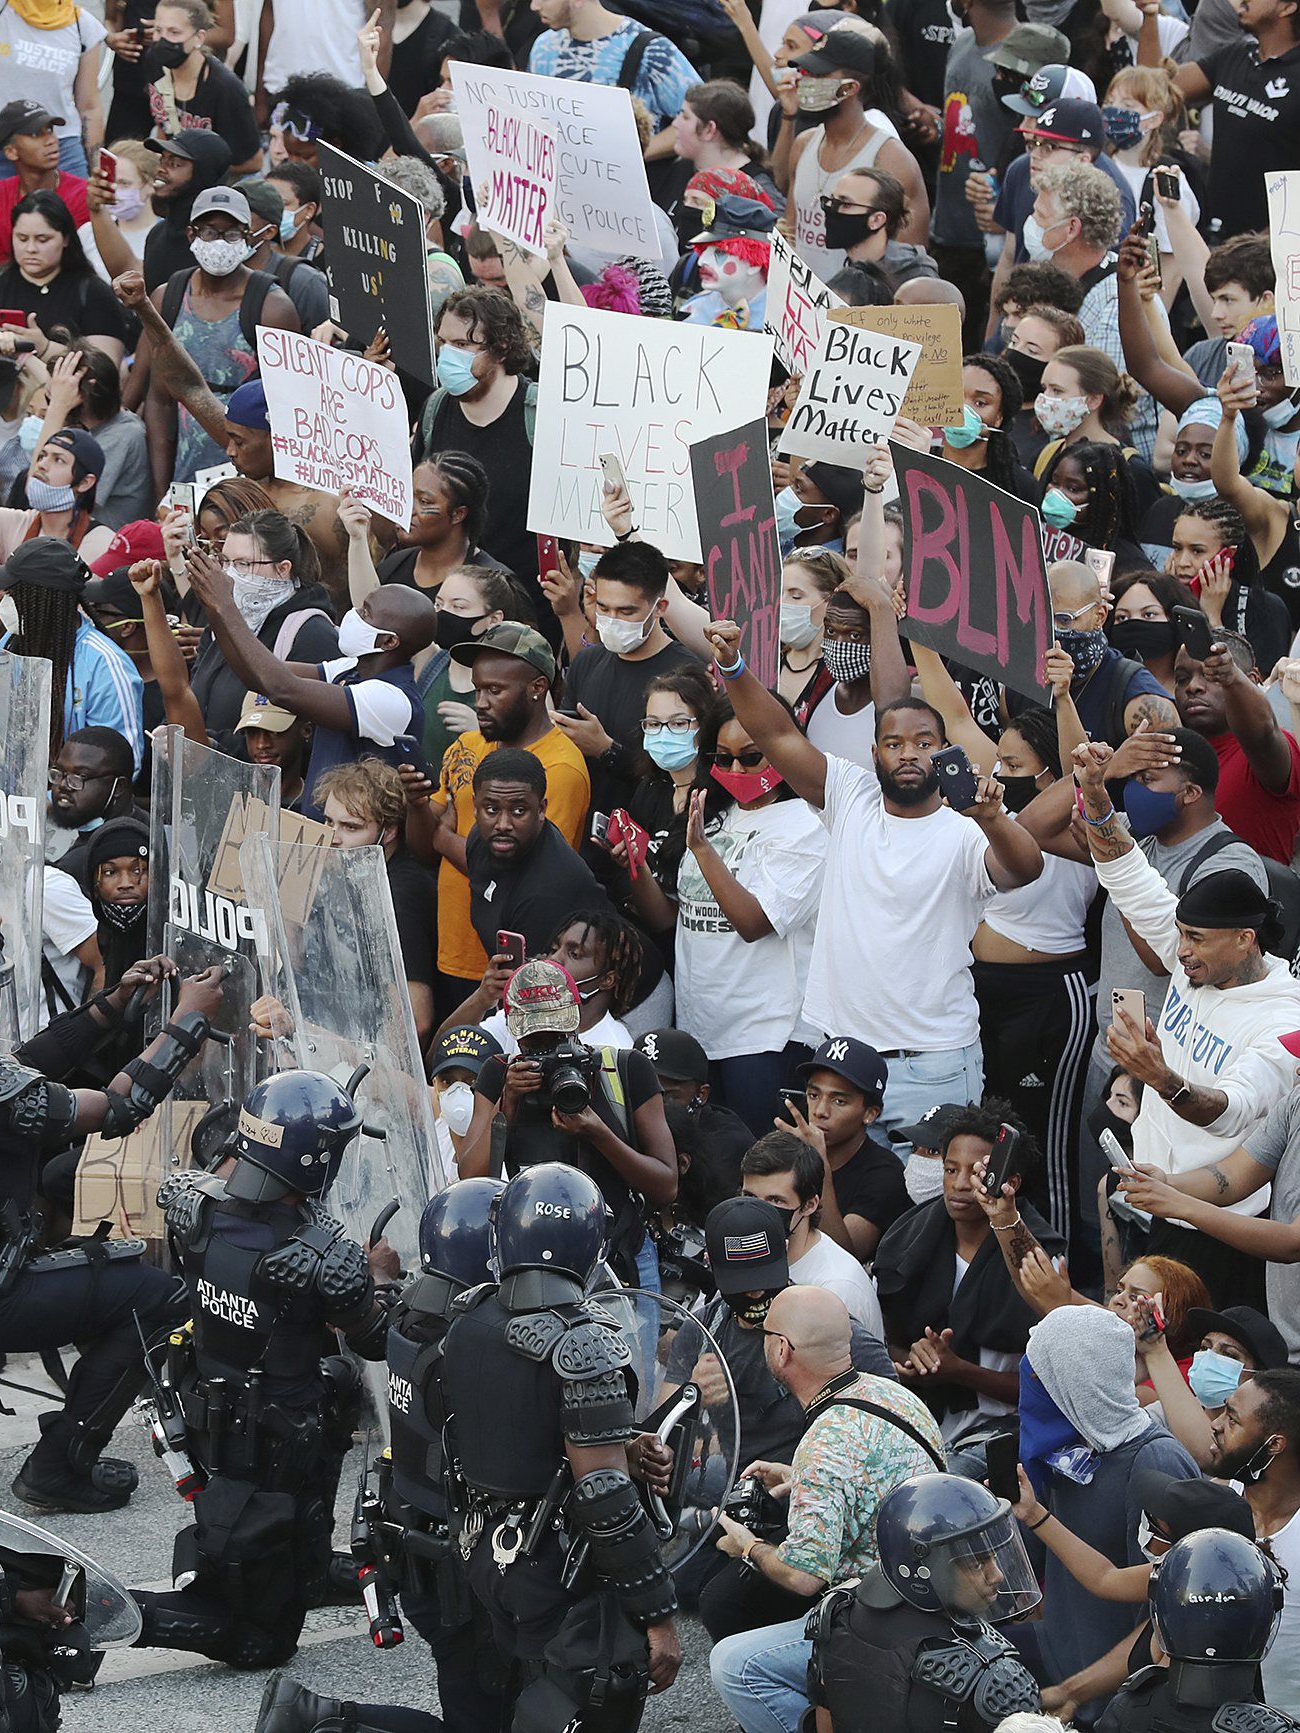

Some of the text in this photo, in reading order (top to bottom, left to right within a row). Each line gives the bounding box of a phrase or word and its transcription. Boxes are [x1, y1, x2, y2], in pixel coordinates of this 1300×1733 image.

[15, 39, 76, 64] JUSTICE
[16, 53, 67, 75] PEACE
[504, 83, 585, 118] JUSTICE
[487, 108, 556, 183] BLACK LIVES
[557, 120, 597, 146] ACE
[560, 151, 622, 184] CUTE
[323, 176, 354, 201] STOP
[486, 168, 548, 249] MATTER
[582, 203, 647, 243] POLICE
[342, 225, 397, 263] KILLING
[876, 314, 899, 331] only
[903, 312, 932, 329] white
[262, 331, 396, 410] SILENT COPS
[560, 323, 726, 415] BLACK
[824, 325, 913, 377] Black
[931, 348, 949, 359] NO
[320, 383, 348, 425] ARE
[808, 369, 901, 418] Lives
[294, 407, 383, 469] BAD COPS
[791, 404, 887, 446] Matter
[560, 417, 693, 476] LIVES
[713, 441, 758, 528] I
[550, 474, 684, 540] MATER
[905, 468, 1049, 688] BLM
[518, 985, 560, 999] WKU
[446, 1047, 479, 1057] VETERAN
[459, 1029, 488, 1046] NAVY
[535, 1201, 572, 1219] ROSE
[196, 1277, 259, 1318] ATLANTA
[201, 1294, 255, 1330] POLICE
